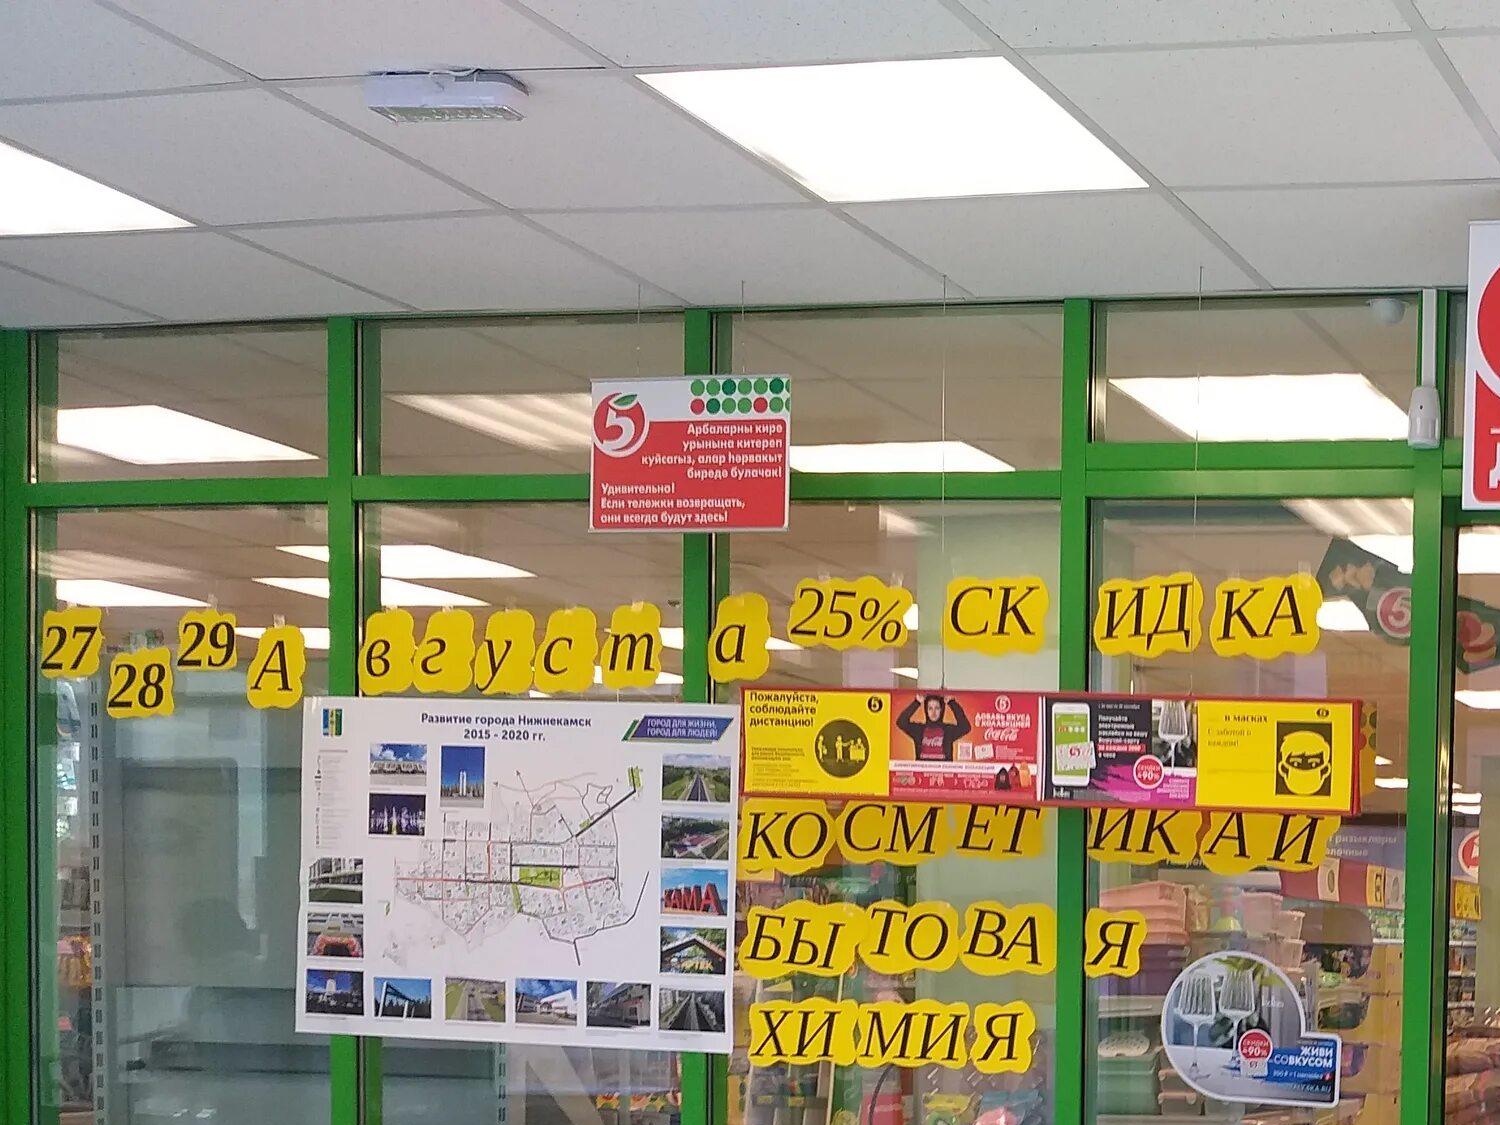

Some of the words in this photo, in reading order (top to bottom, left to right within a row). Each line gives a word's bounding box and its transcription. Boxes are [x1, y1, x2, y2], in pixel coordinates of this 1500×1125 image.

[687, 423, 753, 436] Арбаларны
[683, 438, 735, 451] урынына
[641, 453, 695, 467] куйсагыз,
[698, 454, 726, 466] алар
[731, 466, 782, 480] булачак!
[601, 482, 675, 495] Удивительно!
[601, 498, 626, 509] Если
[627, 499, 674, 509] тележки
[676, 498, 746, 511] возвращать,
[601, 514, 621, 523] они
[623, 513, 658, 524] всегда
[661, 512, 692, 525] будут
[695, 511, 728, 523] здесь!
[790, 586, 904, 643] 25%
[41, 625, 98, 672] 27
[178, 619, 236, 667] 29
[107, 662, 166, 711] 28
[749, 691, 819, 704] Пожалуйста,
[749, 703, 817, 715] соблюдайте
[421, 712, 472, 724] Развитие
[475, 715, 515, 727] города
[518, 714, 592, 728] Нижнекамск
[646, 718, 671, 728] ГОРОД
[672, 719, 687, 729] ДЛЯ
[749, 716, 814, 728] дистанцию!
[1233, 714, 1268, 723] масках
[463, 728, 491, 740] 2015
[501, 730, 530, 741] 2020
[532, 731, 547, 742] гг.
[646, 727, 671, 737] ГОРОД
[671, 728, 687, 738] ДЛЯ
[1327, 847, 1369, 857] лочные
[749, 1008, 1024, 1063] ХИМИЯ
[1300, 1046, 1334, 1058] ЖИВИ
